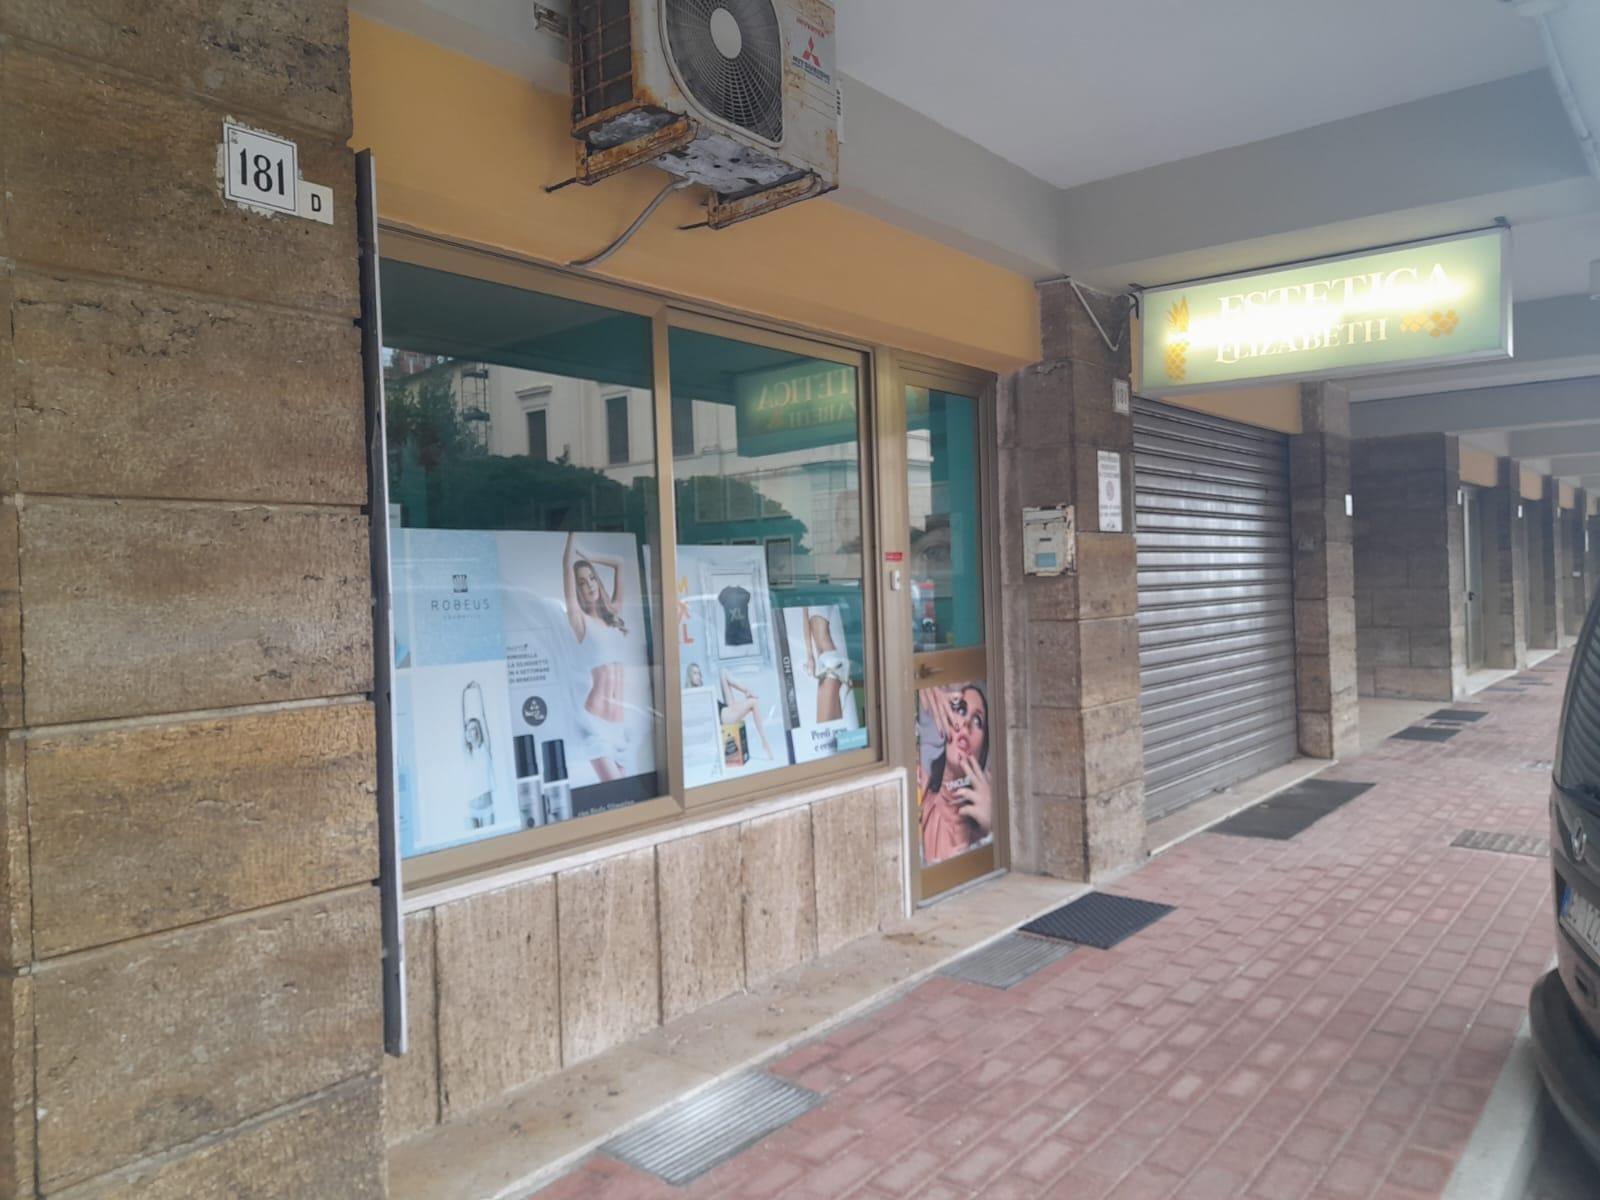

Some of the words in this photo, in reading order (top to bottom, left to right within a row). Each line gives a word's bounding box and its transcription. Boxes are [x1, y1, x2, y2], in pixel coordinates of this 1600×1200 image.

[240, 148, 285, 195] 181
[311, 192, 322, 212] D
[1218, 263, 1453, 325] ESTETICA
[430, 598, 490, 611] ROBEUS
